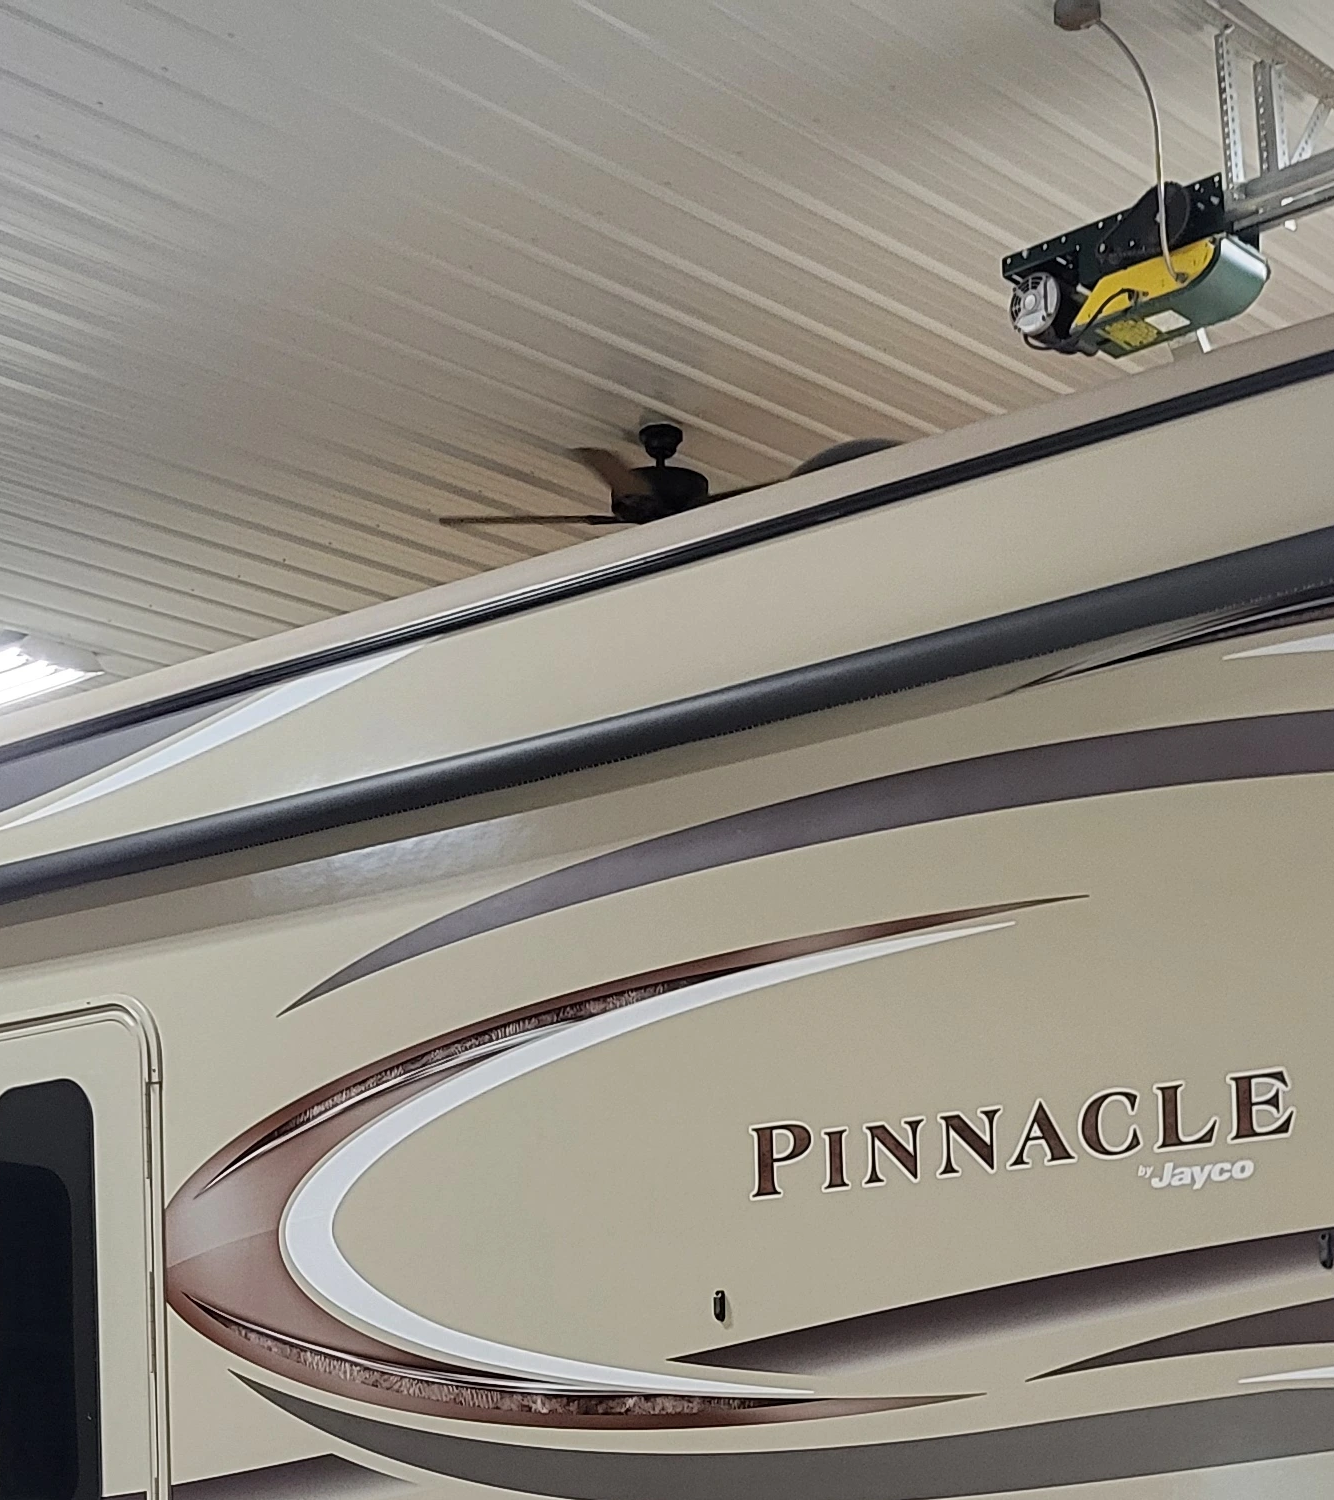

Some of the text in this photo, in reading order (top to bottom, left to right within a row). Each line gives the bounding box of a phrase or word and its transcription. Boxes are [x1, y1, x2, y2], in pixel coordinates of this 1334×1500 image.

[750, 1067, 1296, 1200] PINNACLE
[1137, 1159, 1255, 1190] by Jayco
